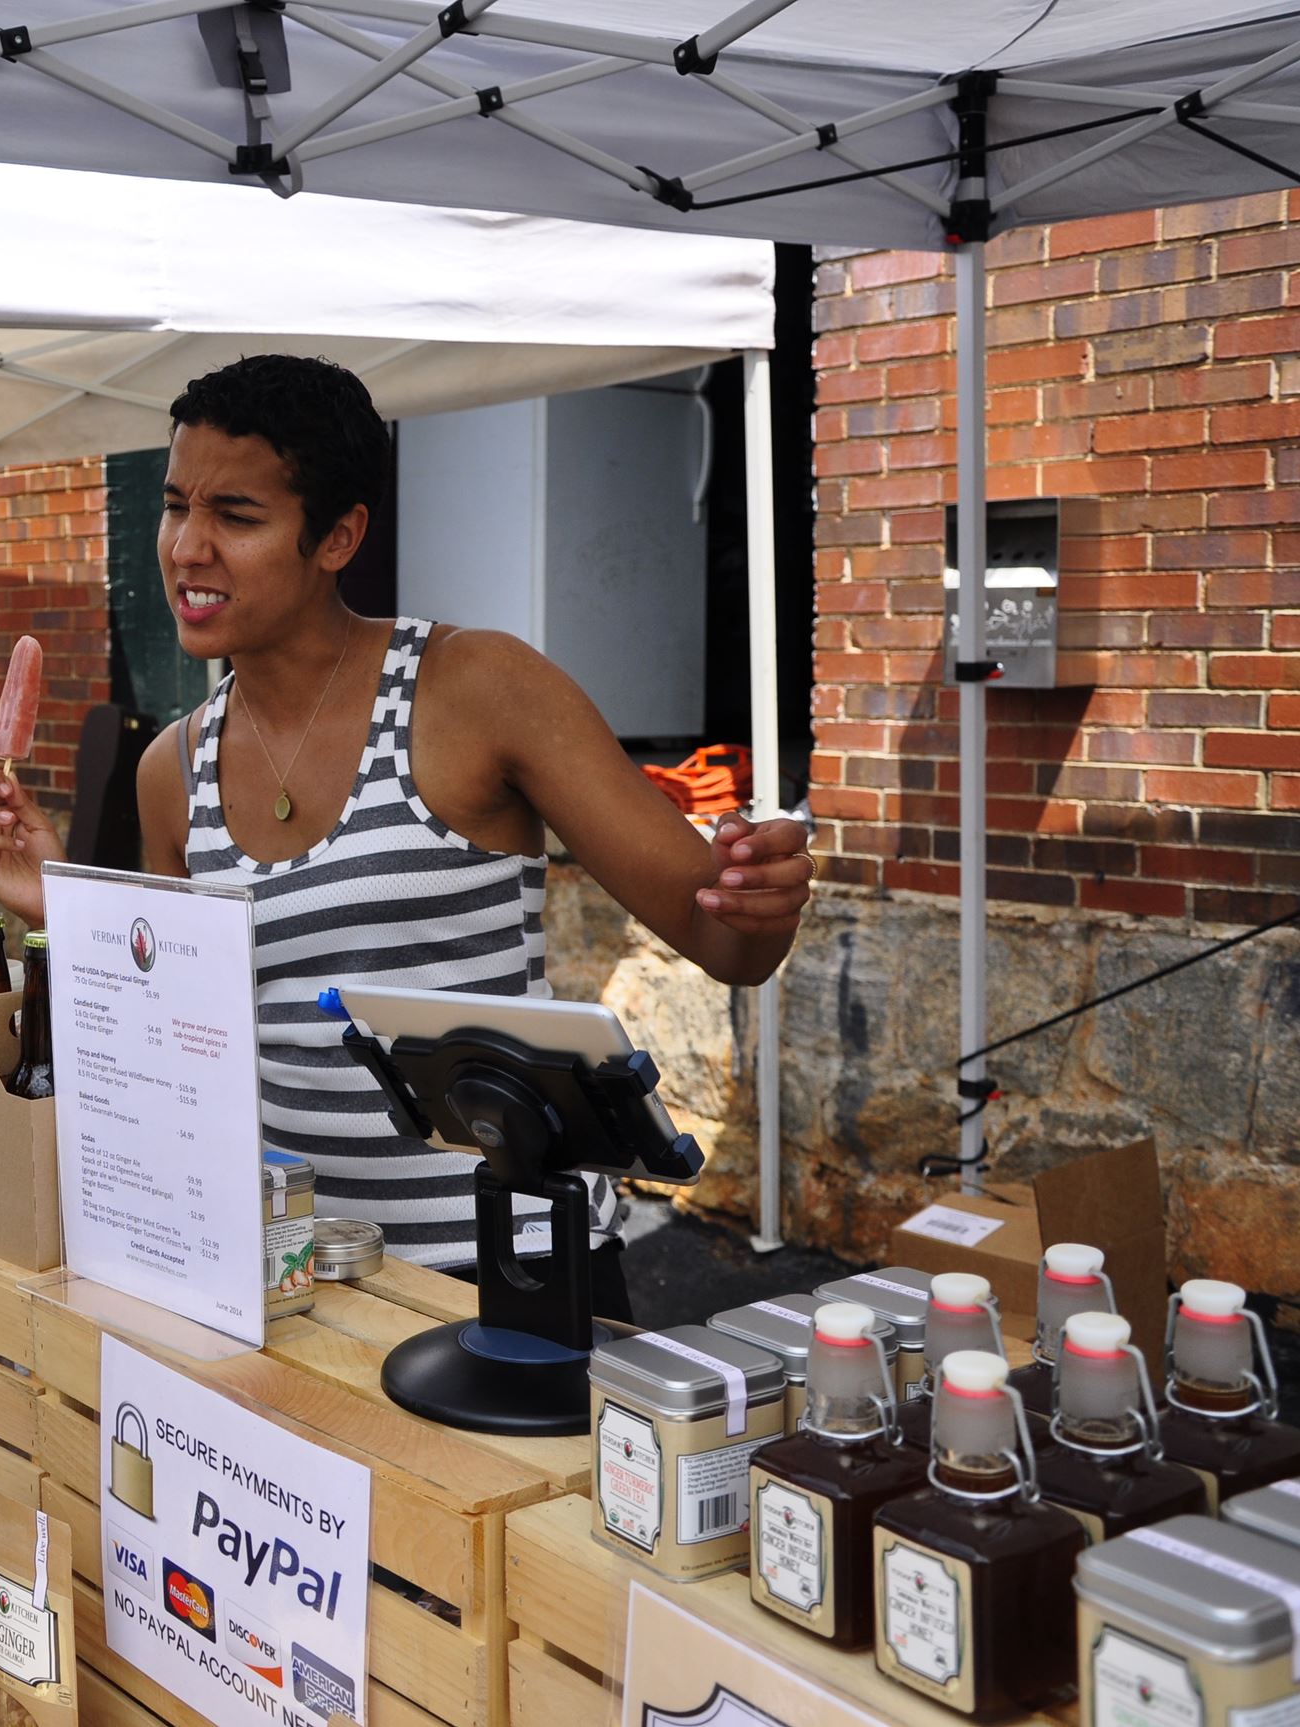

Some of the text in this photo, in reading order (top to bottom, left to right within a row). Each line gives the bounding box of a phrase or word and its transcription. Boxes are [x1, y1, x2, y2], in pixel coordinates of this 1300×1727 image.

[91, 929, 198, 958] VERDANT KITCHEN
[72, 965, 150, 988] Dried USDA Organic Local Ginger
[88, 980, 105, 989] Ground
[107, 983, 122, 994] Ginger
[146, 990, 160, 1000] $5.99
[74, 998, 110, 1014] Candied Ginger
[90, 1013, 106, 1024] Ginger
[106, 1016, 118, 1025] Bites
[86, 1023, 96, 1031] Bare
[96, 1025, 114, 1037] Ginger
[172, 1019, 228, 1039] We grow and process
[148, 1036, 162, 1047] $7.99
[173, 1030, 204, 1045] sub-tropical
[205, 1038, 220, 1049] spices
[77, 1047, 116, 1065] Syrup and Honey
[181, 1044, 208, 1058] Savannah,
[93, 1062, 109, 1074] Ginger
[110, 1066, 127, 1077] Infused
[128, 1071, 154, 1084] Wildflower
[156, 1078, 172, 1090] Honey
[99, 1074, 114, 1086] Ginger
[114, 1078, 128, 1090] Syrup
[79, 1091, 110, 1106] Baked Goods
[179, 1083, 196, 1096] $15.99
[179, 1095, 197, 1107] $15.99
[91, 1105, 113, 1118] Savannah
[114, 1112, 128, 1124] Snaps
[128, 1116, 140, 1127] pack
[81, 1133, 95, 1144] Sodas
[180, 1130, 194, 1142] $4.99
[116, 1154, 132, 1167] Ginger
[116, 1164, 140, 1181] Ogeechee
[141, 1173, 153, 1183] Gold
[82, 1165, 98, 1178] (ginger
[120, 1177, 141, 1191] turmeric
[152, 1186, 174, 1203] galangal)
[82, 1177, 114, 1194] Single Bottles
[82, 1188, 92, 1198] Teas
[106, 1206, 125, 1222] Organic
[126, 1213, 143, 1227] Ginger
[143, 1218, 155, 1229] Mint
[156, 1222, 171, 1235] Green
[191, 1211, 205, 1223] $2.99
[107, 1217, 125, 1233] Organic
[126, 1224, 143, 1238] Ginger
[144, 1229, 165, 1244] Turmeric
[166, 1237, 181, 1250] Green
[131, 1240, 185, 1268] Credit Cards Accepted
[216, 1300, 242, 1317] June 2014
[602, 1435, 655, 1465] VERDANT KITCHEN
[156, 1418, 346, 1540] SECURE PAYMENTS BY
[604, 1461, 655, 1496] GINGER TURMERIC
[611, 1478, 646, 1505] GREEN TEA
[112, 1539, 148, 1581] VISA
[192, 1490, 342, 1621] PayPal
[169, 1583, 209, 1618] MasterCard
[11, 1603, 38, 1624] KITCHEN
[229, 1619, 276, 1661] DISCOVER
[115, 1589, 134, 1618] NO
[139, 1607, 195, 1663] PAYPAL
[199, 1649, 278, 1717] ACCOUNT
[292, 1656, 353, 1710] AMERICAN
